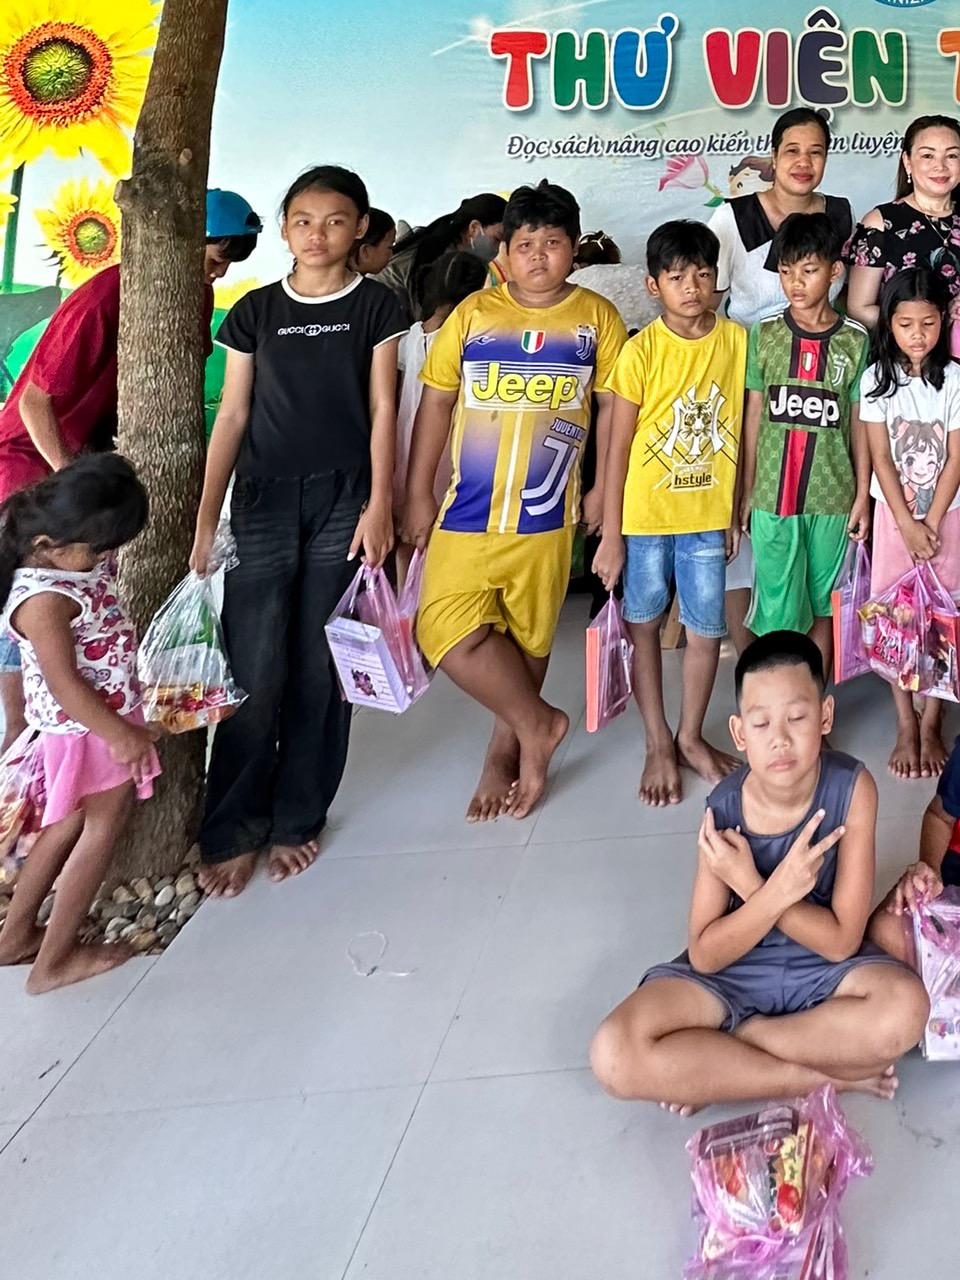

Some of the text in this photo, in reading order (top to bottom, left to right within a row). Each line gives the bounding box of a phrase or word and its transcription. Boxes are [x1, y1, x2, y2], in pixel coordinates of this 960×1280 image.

[489, 12, 678, 110] THƯ
[704, 5, 907, 122] VIỆN
[507, 135, 548, 160] Đọc
[552, 134, 600, 155] sách
[605, 133, 659, 157] nâng
[665, 137, 701, 153] cao
[706, 130, 748, 152] kiến
[851, 132, 905, 155] luyện
[277, 323, 350, 336] GUCCI GUCCI
[472, 362, 579, 410] Jeep
[770, 386, 840, 427] Jeep
[674, 473, 712, 486] hstyle
